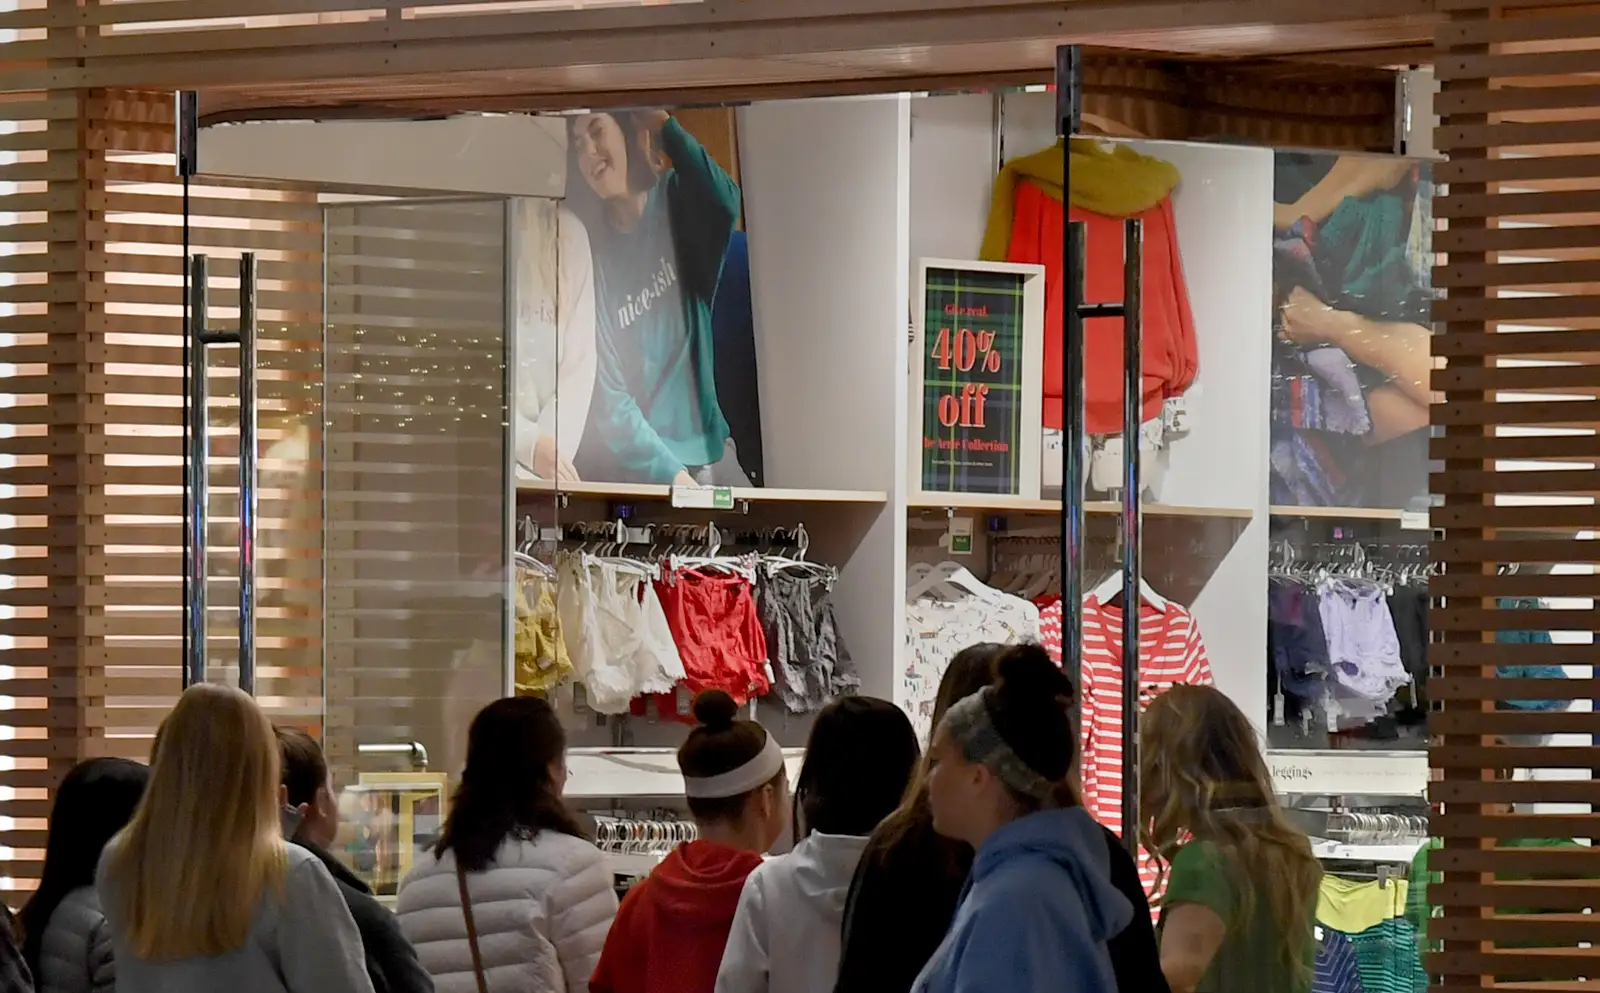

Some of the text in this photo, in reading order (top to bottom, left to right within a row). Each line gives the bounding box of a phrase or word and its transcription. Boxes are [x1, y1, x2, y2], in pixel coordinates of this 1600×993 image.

[617, 256, 678, 330] nice-ish
[930, 327, 1001, 373] 40%
[937, 382, 989, 428] off
[1271, 765, 1313, 781] leggings
